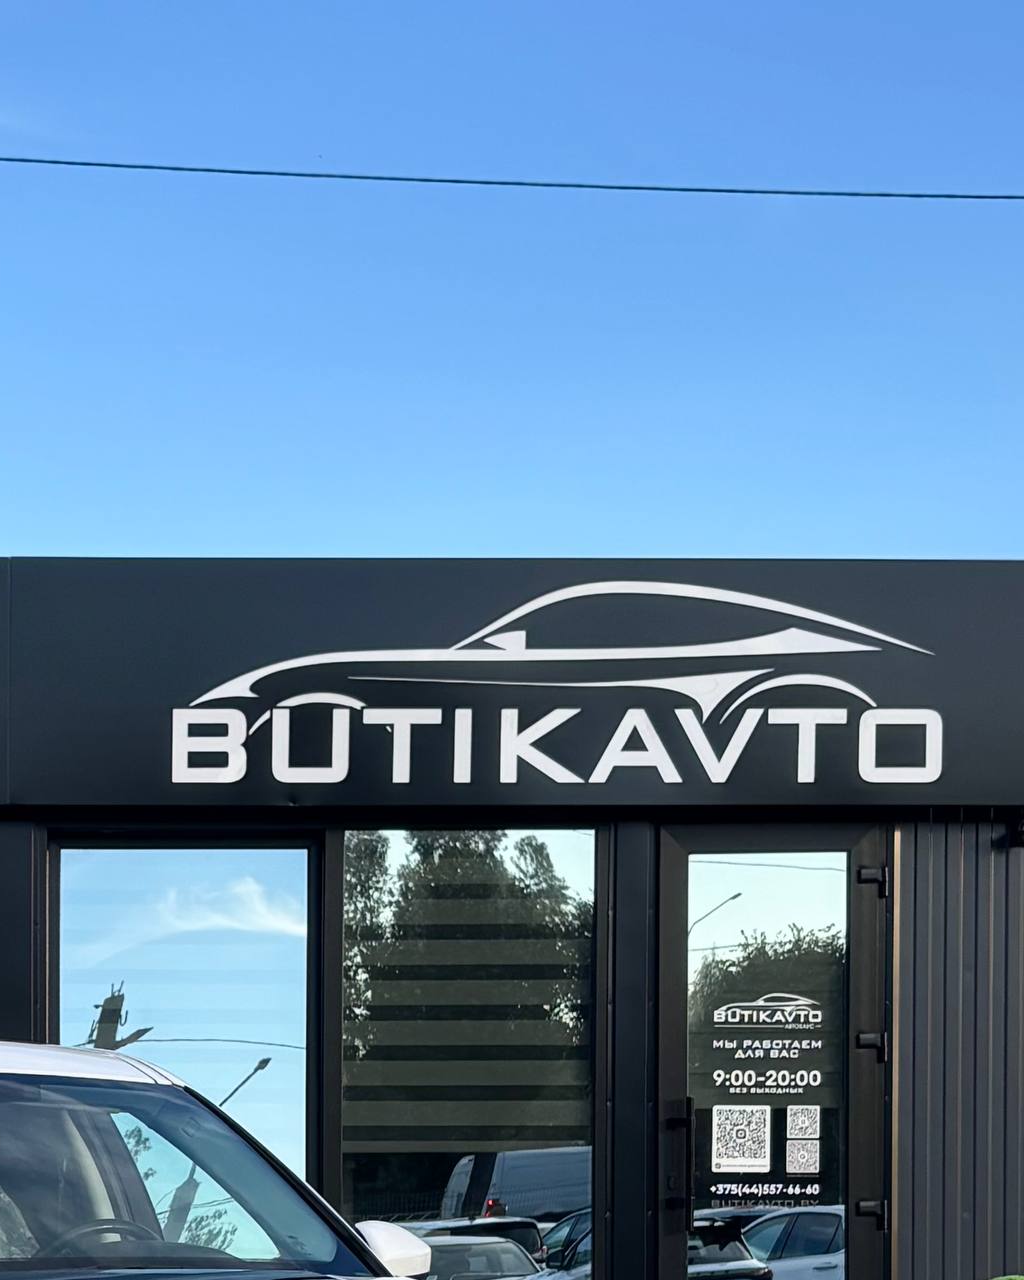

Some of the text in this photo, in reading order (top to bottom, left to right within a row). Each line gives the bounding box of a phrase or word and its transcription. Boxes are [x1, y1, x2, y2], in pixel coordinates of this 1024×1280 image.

[171, 707, 944, 785] BUTIKAVTO
[714, 1010, 822, 1023] BUTIKAVTO
[712, 1039, 822, 1049] МЫ РАБОТАЕМ
[734, 1049, 799, 1059] ДЛЯ ВАС
[712, 1069, 822, 1087] 9:00-20:00
[729, 1086, 804, 1094] БЕЗ ВЫХОДНЫХ
[709, 1183, 821, 1197] +375(44)557-66-60
